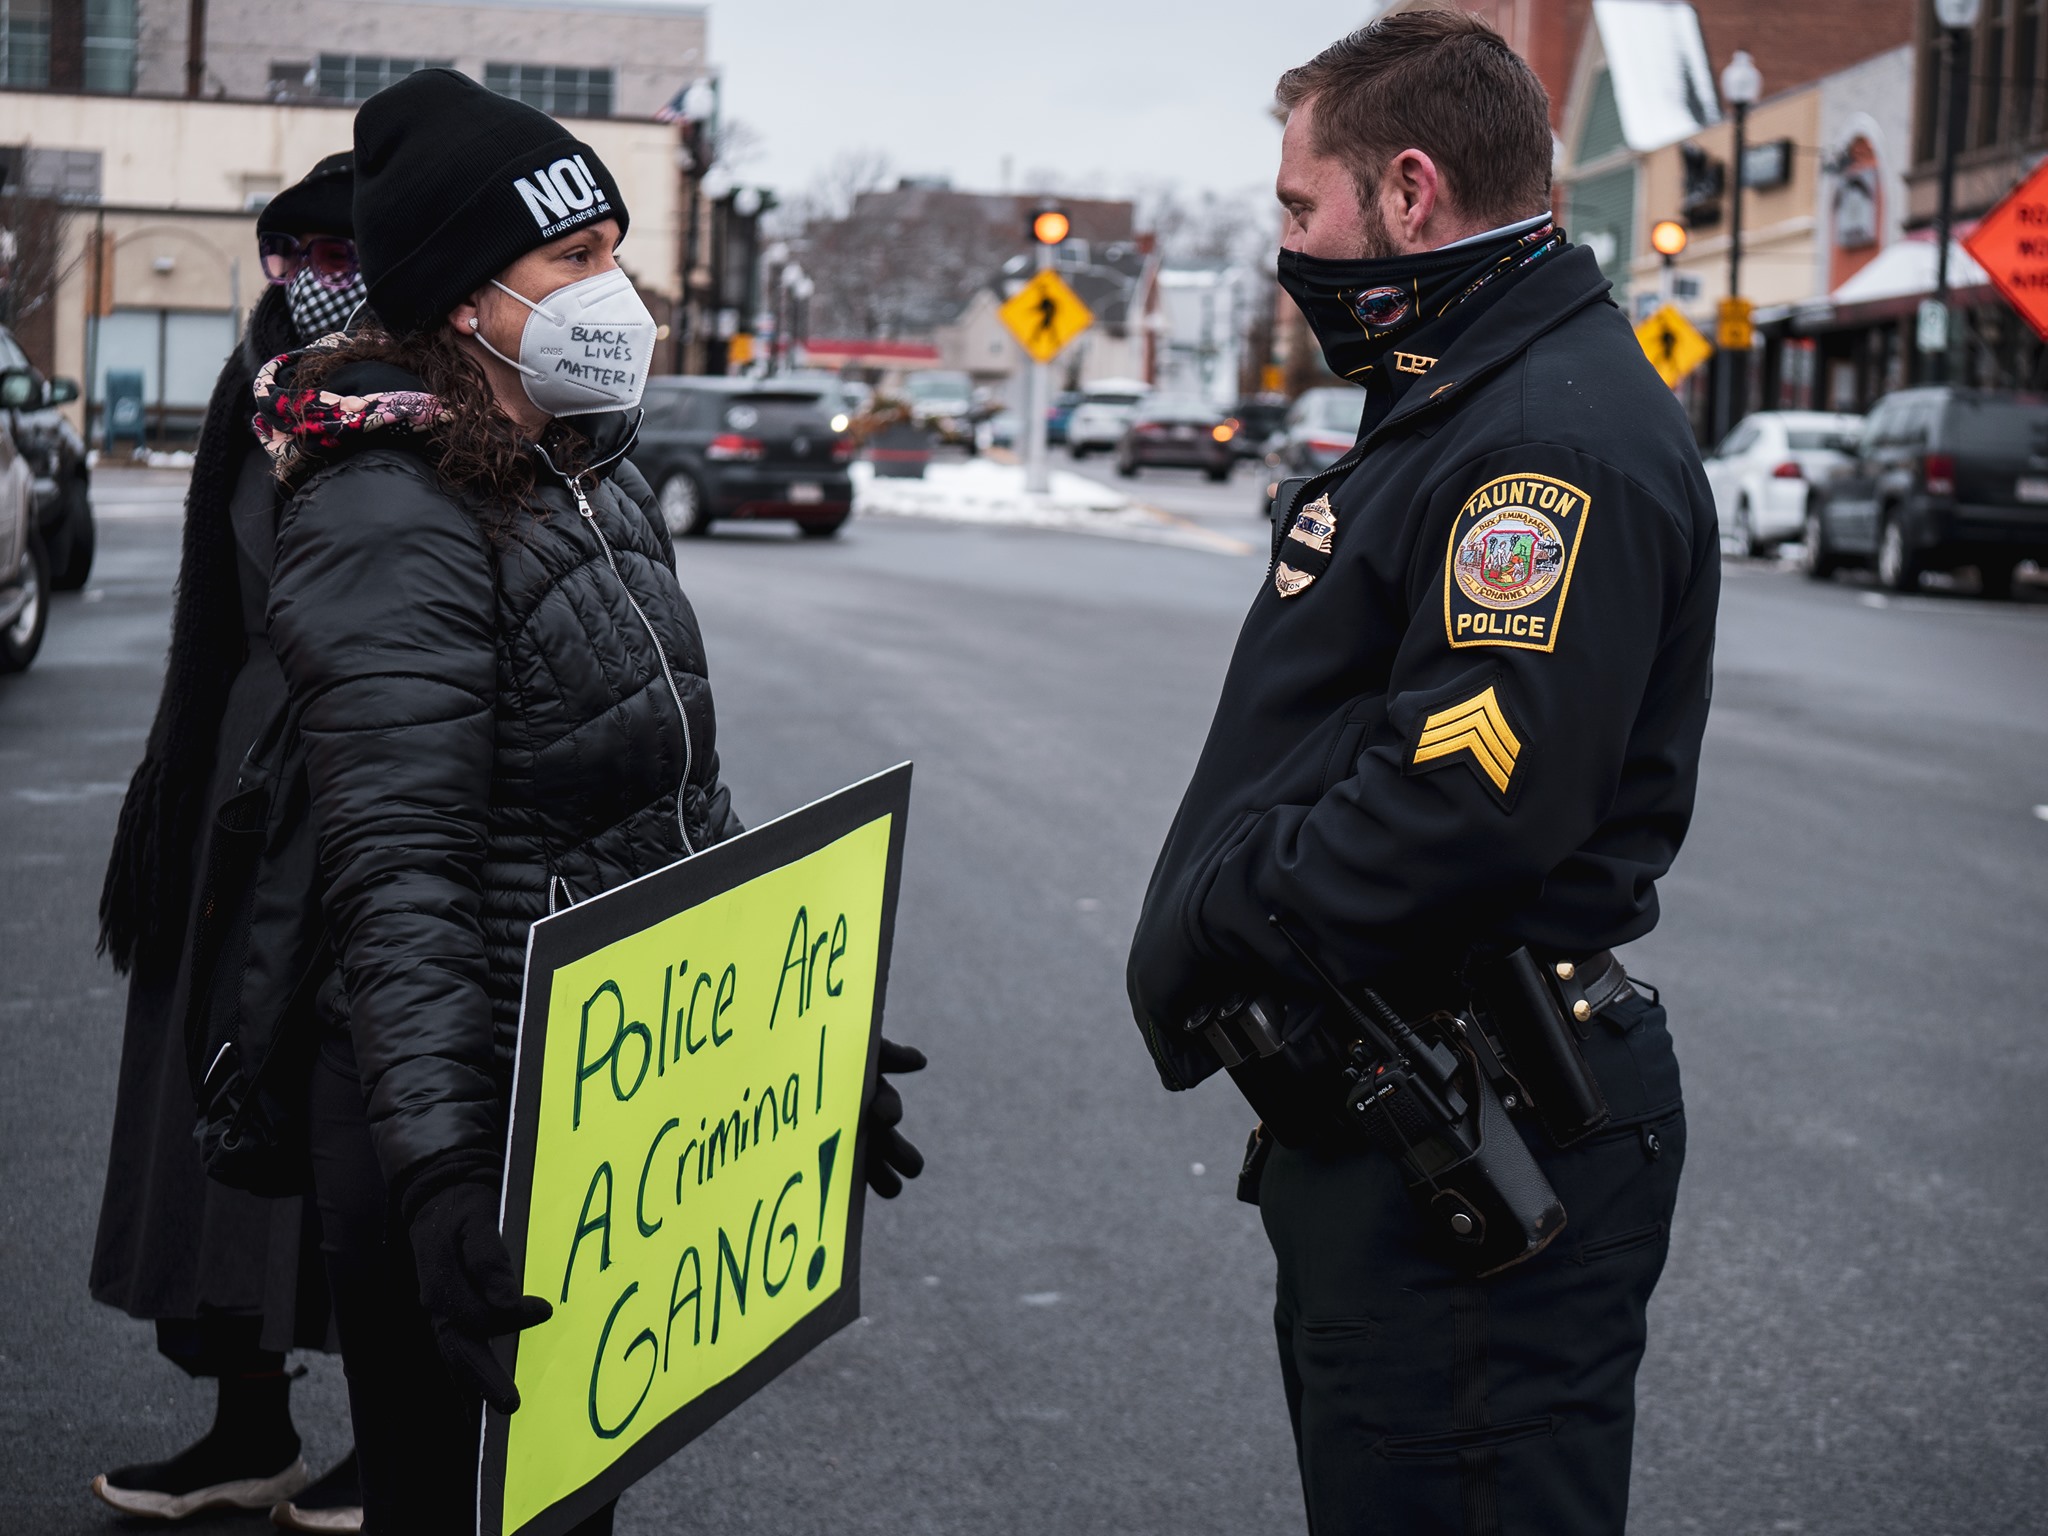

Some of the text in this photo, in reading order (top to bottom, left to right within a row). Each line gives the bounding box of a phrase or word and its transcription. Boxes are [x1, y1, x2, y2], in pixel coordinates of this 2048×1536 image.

[513, 154, 606, 228] NO!
[570, 326, 629, 345] BLACK
[540, 346, 563, 356] KN95
[584, 344, 632, 362] LIVES
[555, 358, 635, 392] MATTER!
[1465, 481, 1577, 518] TAUNTON
[1499, 511, 1528, 522] FEMINA
[1480, 586, 1529, 600] COHANNET
[1457, 612, 1546, 639] POLICE
[573, 905, 848, 1131] Police Are
[1364, 1084, 1393, 1105] MOTROLA
[560, 1024, 828, 1305] A Criminal
[588, 1128, 842, 1440] GANG!
